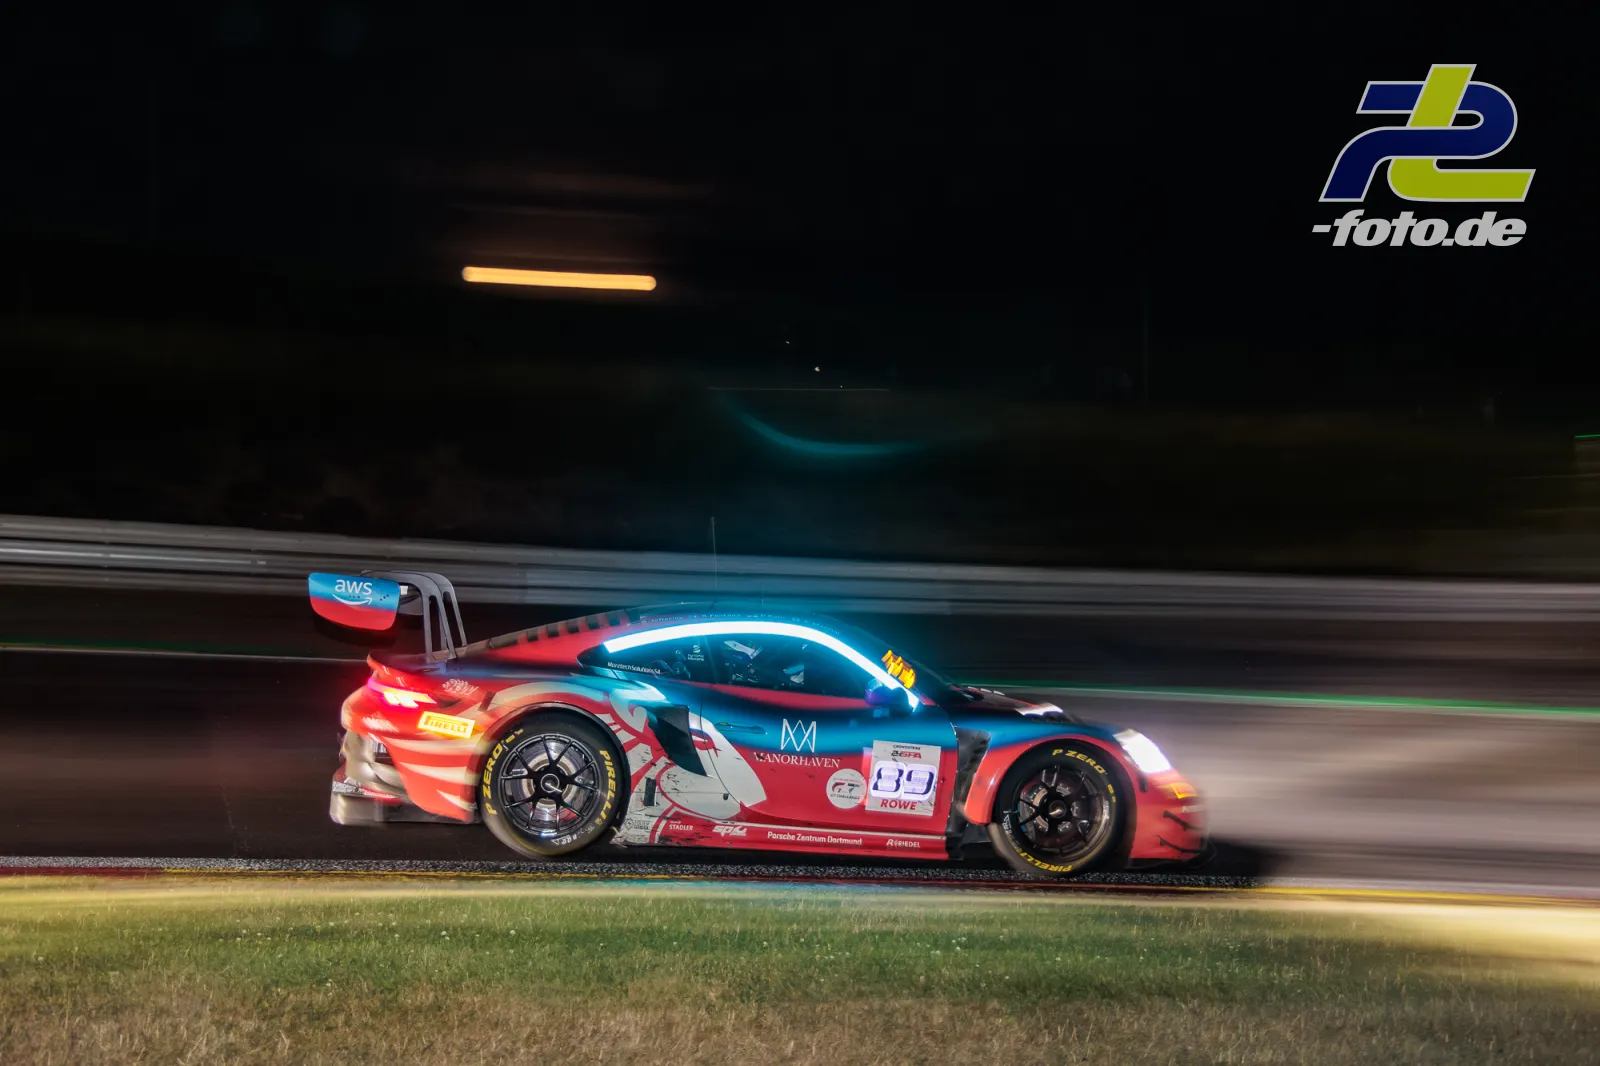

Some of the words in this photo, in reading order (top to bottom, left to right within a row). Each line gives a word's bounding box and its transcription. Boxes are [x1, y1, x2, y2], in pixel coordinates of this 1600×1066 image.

[334, 578, 373, 596] aws
[1052, 748, 1063, 756] P
[1065, 750, 1106, 774] ZERO
[482, 743, 503, 799] ZERO
[599, 750, 616, 820] PIRELLI
[871, 765, 936, 797] 89
[485, 802, 497, 815] P
[880, 798, 918, 811] ROWE
[669, 823, 694, 832] STADLER
[767, 831, 796, 841] Porsche
[796, 833, 826, 843] Zentrum
[827, 835, 863, 846] Dortmund
[1020, 852, 1072, 872] PIRELLI
